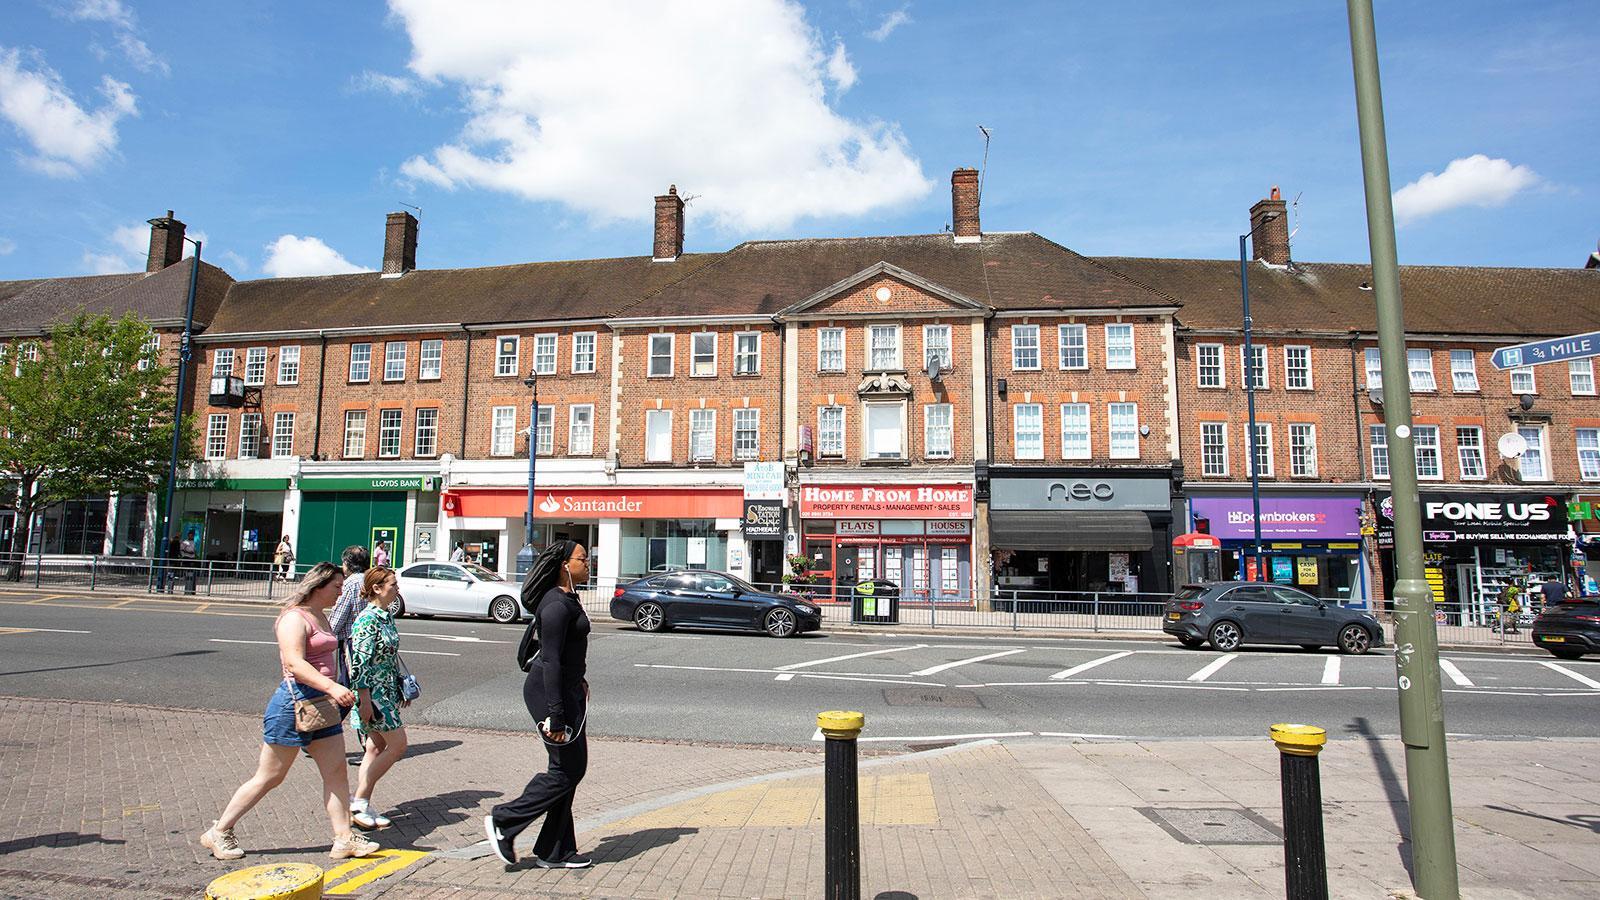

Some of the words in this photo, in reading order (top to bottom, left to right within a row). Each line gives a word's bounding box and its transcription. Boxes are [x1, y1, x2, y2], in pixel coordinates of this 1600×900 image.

[1507, 350, 1519, 364] H
[1550, 339, 1592, 356] MILE
[1047, 481, 1115, 502] neo
[563, 495, 643, 512] Santander
[1426, 502, 1503, 520] FONE
[1506, 503, 1551, 520] US
[840, 521, 875, 530] FLATS
[930, 522, 966, 530] HOUSES
